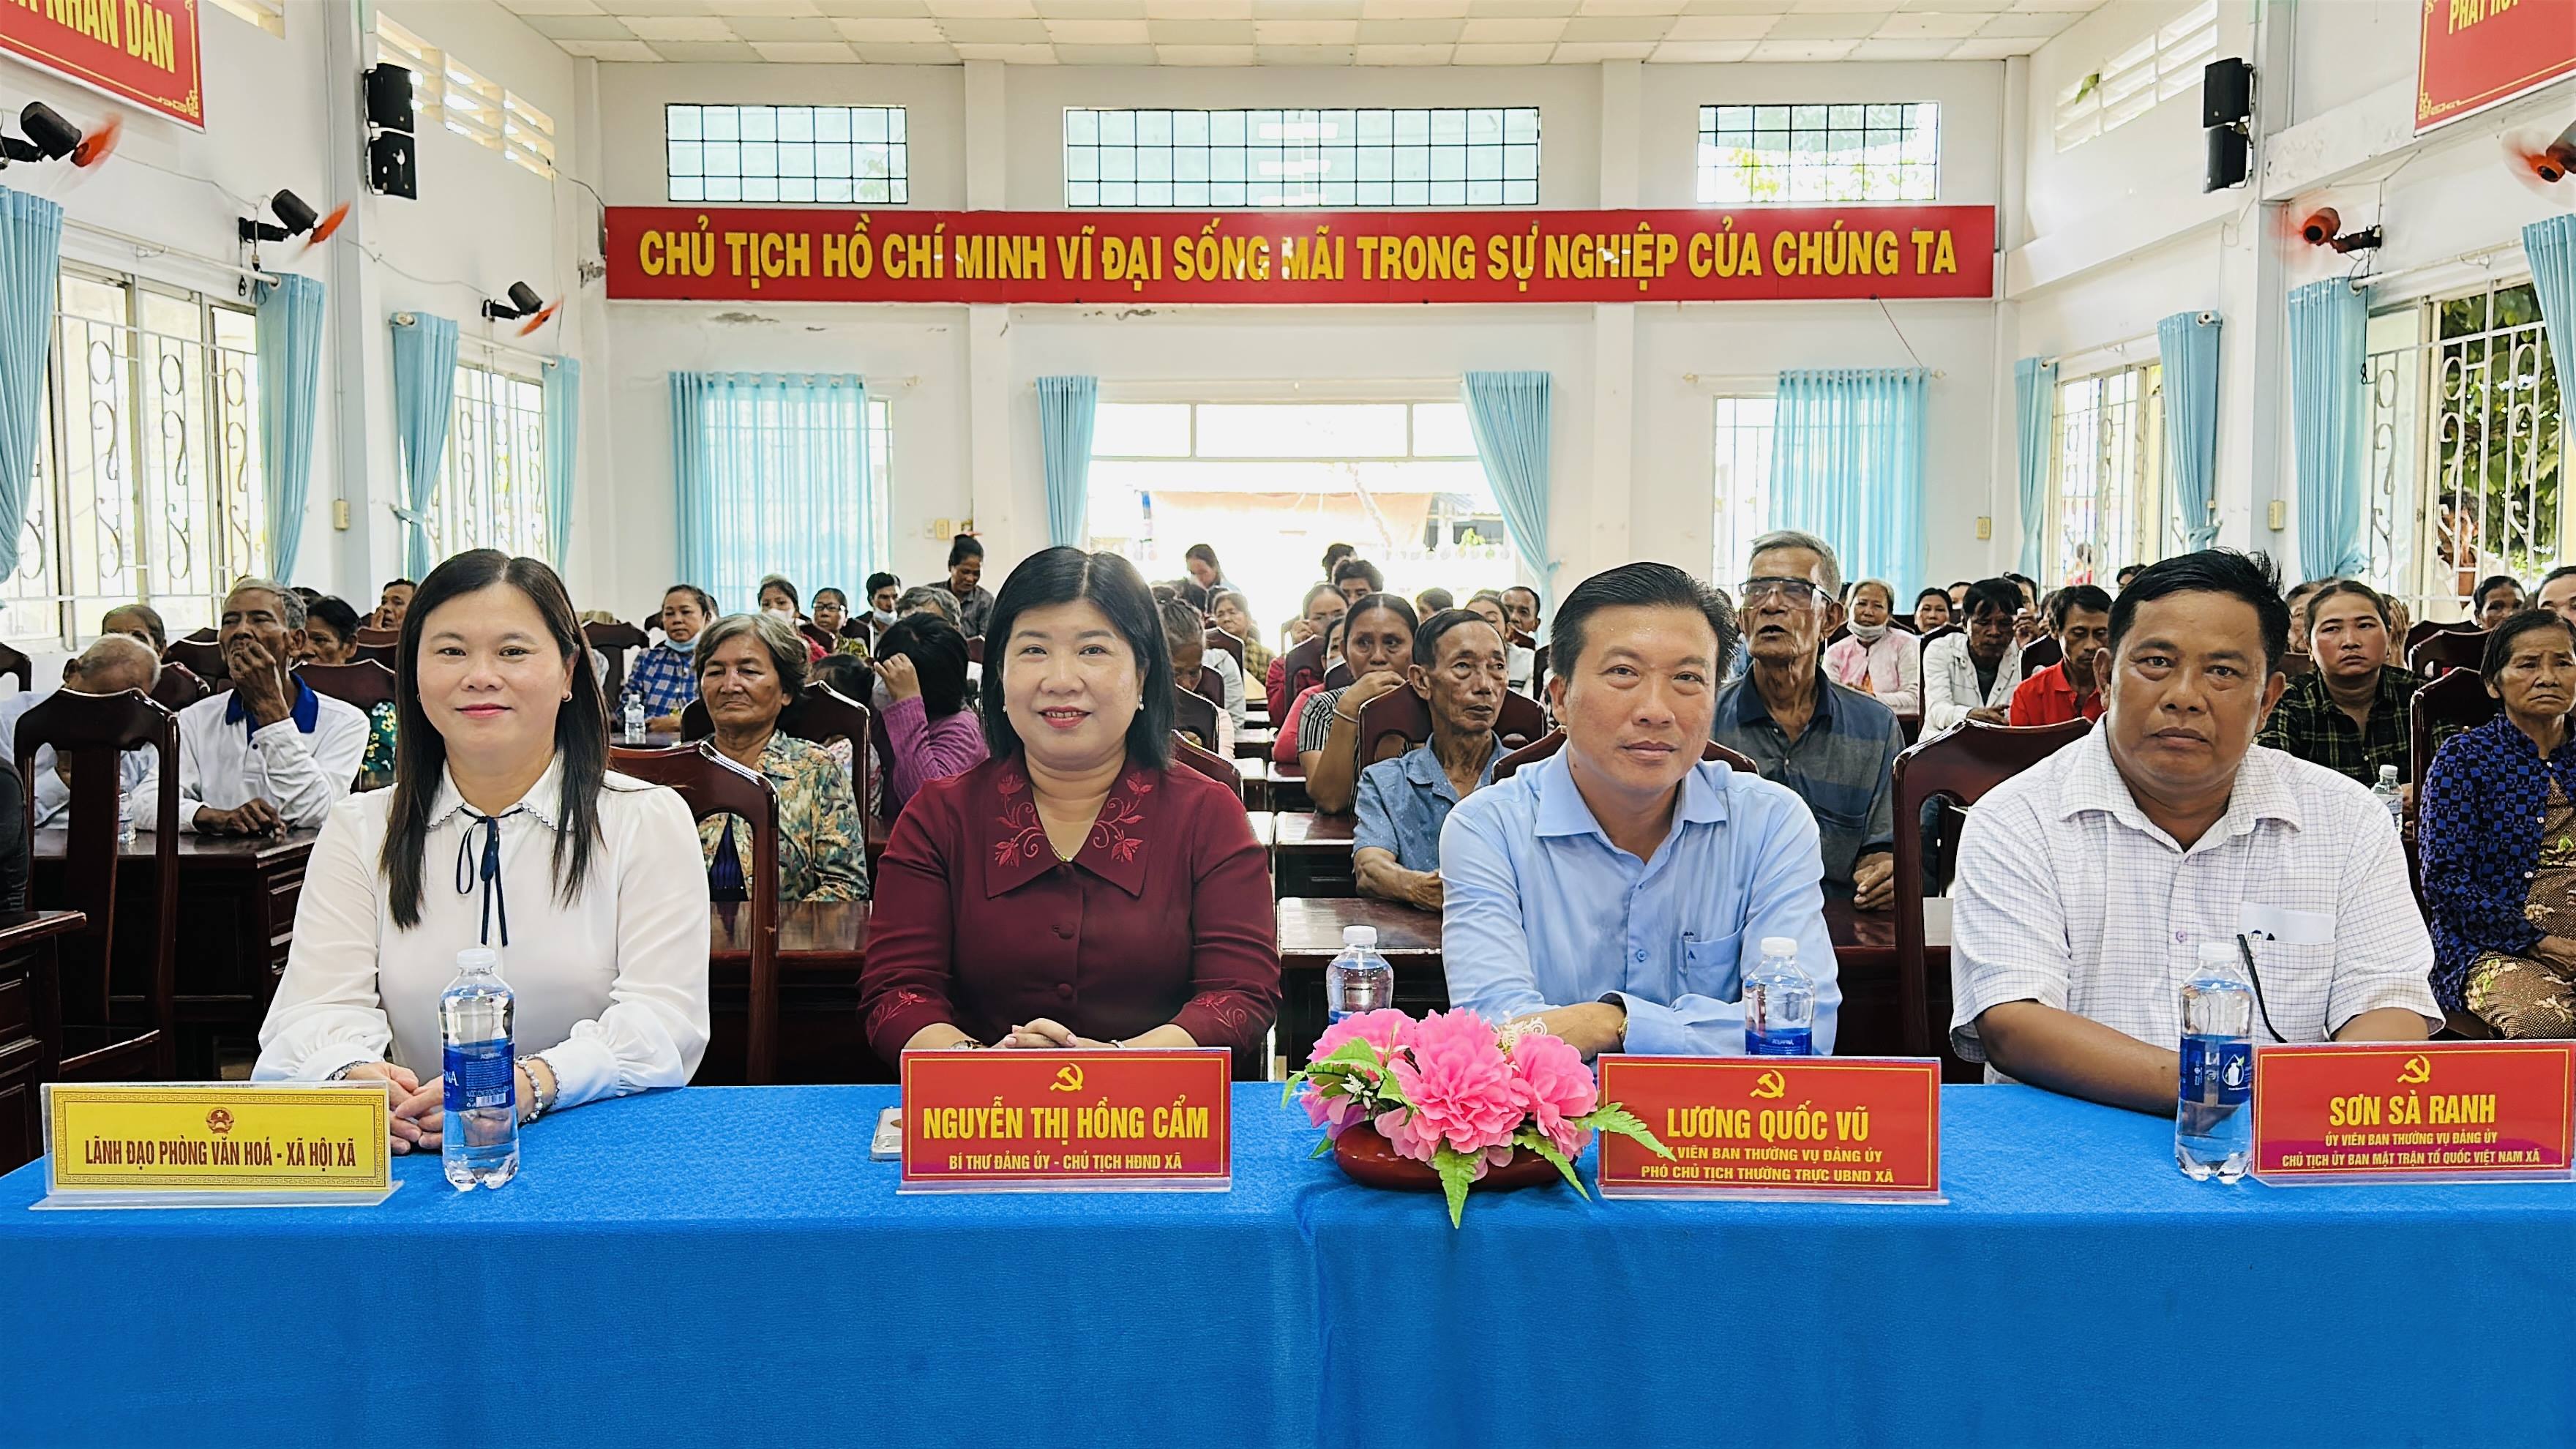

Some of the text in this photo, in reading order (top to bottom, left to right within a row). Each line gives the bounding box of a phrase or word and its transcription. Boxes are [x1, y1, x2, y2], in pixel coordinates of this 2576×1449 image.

[640, 213, 1957, 292] CHỦ TỊCH HỒ CHÍ MINH VĨ ĐẠI SỐNG MÃI TRONG SỰ NGHIỆP CỦA CHÚNG TA
[923, 1094, 1210, 1146] NGUYỄN THỊ HỒNG CẨM
[1667, 1098, 1870, 1143] LƯƠNG QUỐC VŨ
[2329, 1090, 2496, 1127] SƠN SÀ RANH
[85, 1135, 122, 1164] LÃNH
[126, 1140, 154, 1170] ĐẠO
[159, 1135, 207, 1165] PHÒNG
[211, 1136, 239, 1166] VĂN
[244, 1137, 272, 1166] HOÁ
[286, 1137, 305, 1166] XÃ
[310, 1137, 333, 1172] HỘI
[337, 1137, 356, 1167] XÃ
[948, 1153, 963, 1169] BÍ
[966, 1154, 992, 1169] THƯ
[994, 1150, 1030, 1169] ĐẢNG
[1033, 1150, 1051, 1169] ỦY
[1063, 1150, 1090, 1169] CHỦ
[1093, 1155, 1123, 1172] TỊCH
[1125, 1155, 1161, 1169] HĐND
[1165, 1152, 1183, 1169] XÃ
[1677, 1145, 1709, 1159] VIÊN
[1712, 1147, 1741, 1160] BAN
[1745, 1146, 1799, 1161] THƯỜNG
[1802, 1149, 1820, 1164] VỤ
[1823, 1146, 1862, 1162] ĐẢNG
[1865, 1147, 1883, 1163] ỦY
[1641, 1163, 1895, 1183] PHÓ CHỦ TỊCH THƯỜNG TRỰC UBND XÃ
